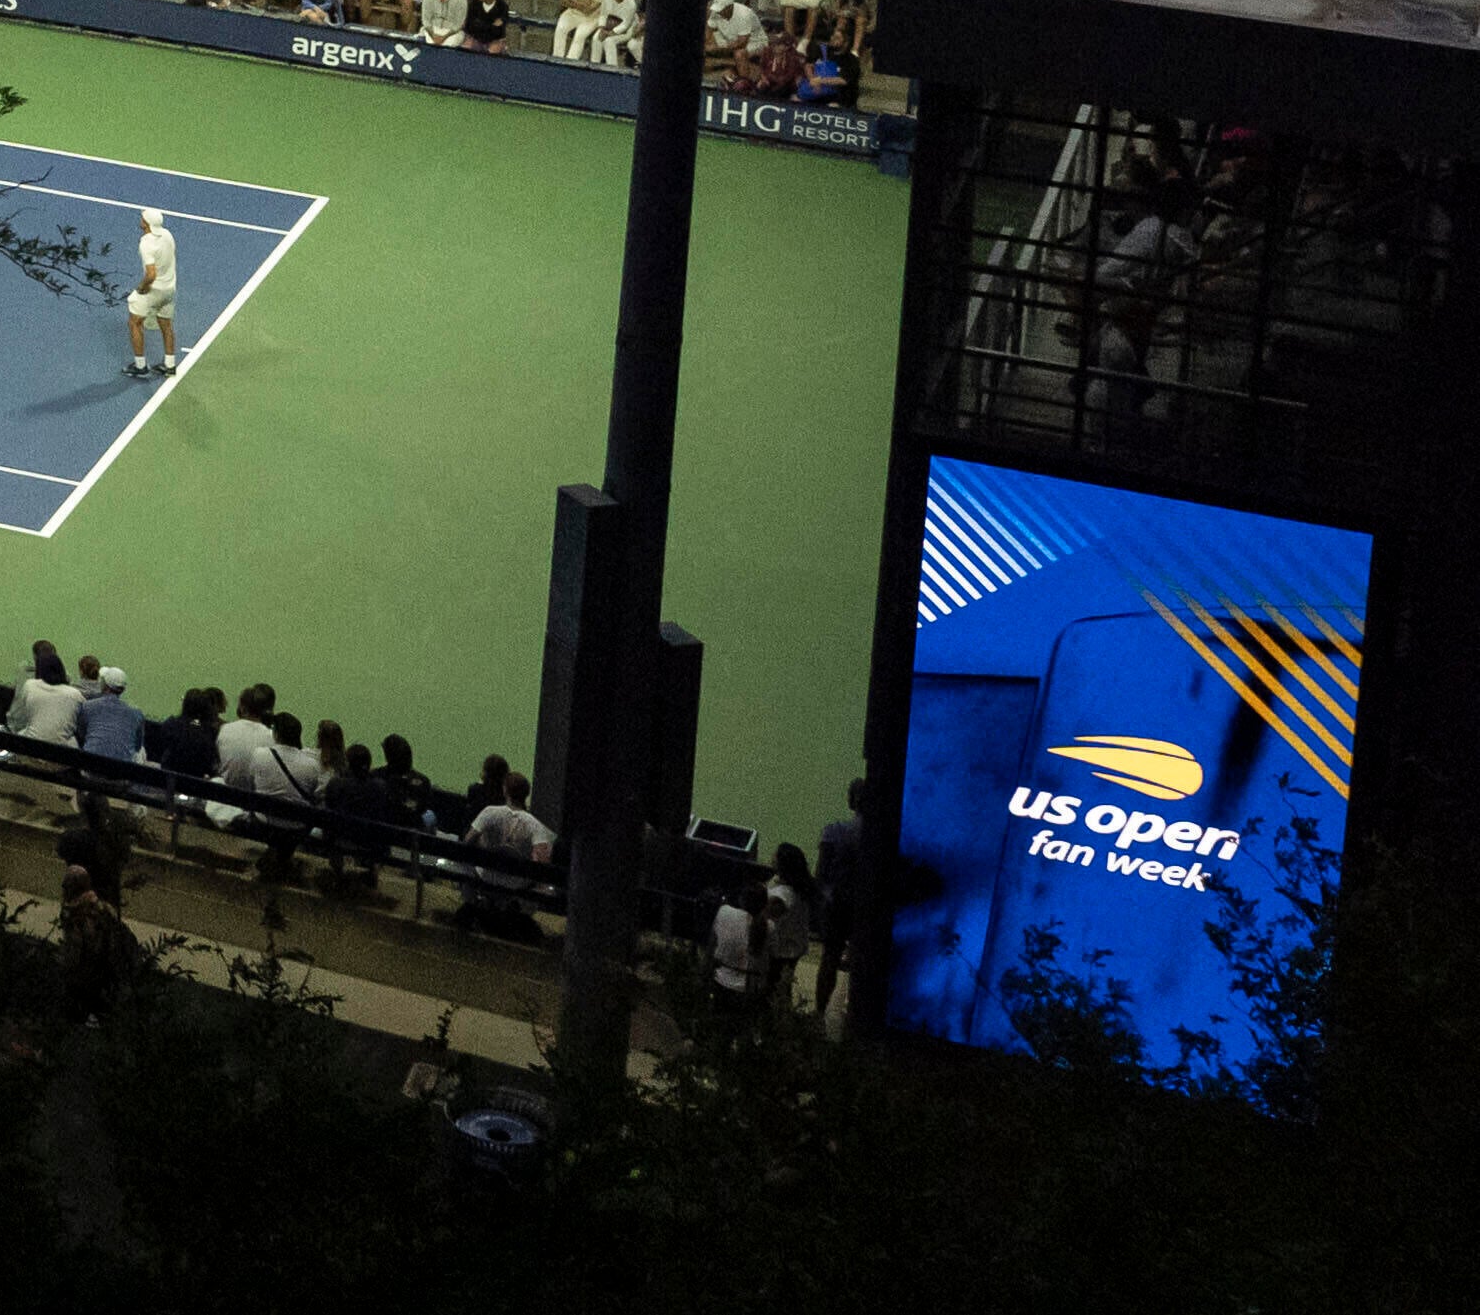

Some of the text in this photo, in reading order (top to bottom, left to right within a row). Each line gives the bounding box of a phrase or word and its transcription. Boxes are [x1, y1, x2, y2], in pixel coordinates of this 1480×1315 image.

[291, 36, 394, 71] argenx
[705, 95, 781, 133] IHG
[793, 110, 869, 132] HOTELS
[1008, 786, 1241, 861] us open
[1028, 829, 1212, 893] fan week
